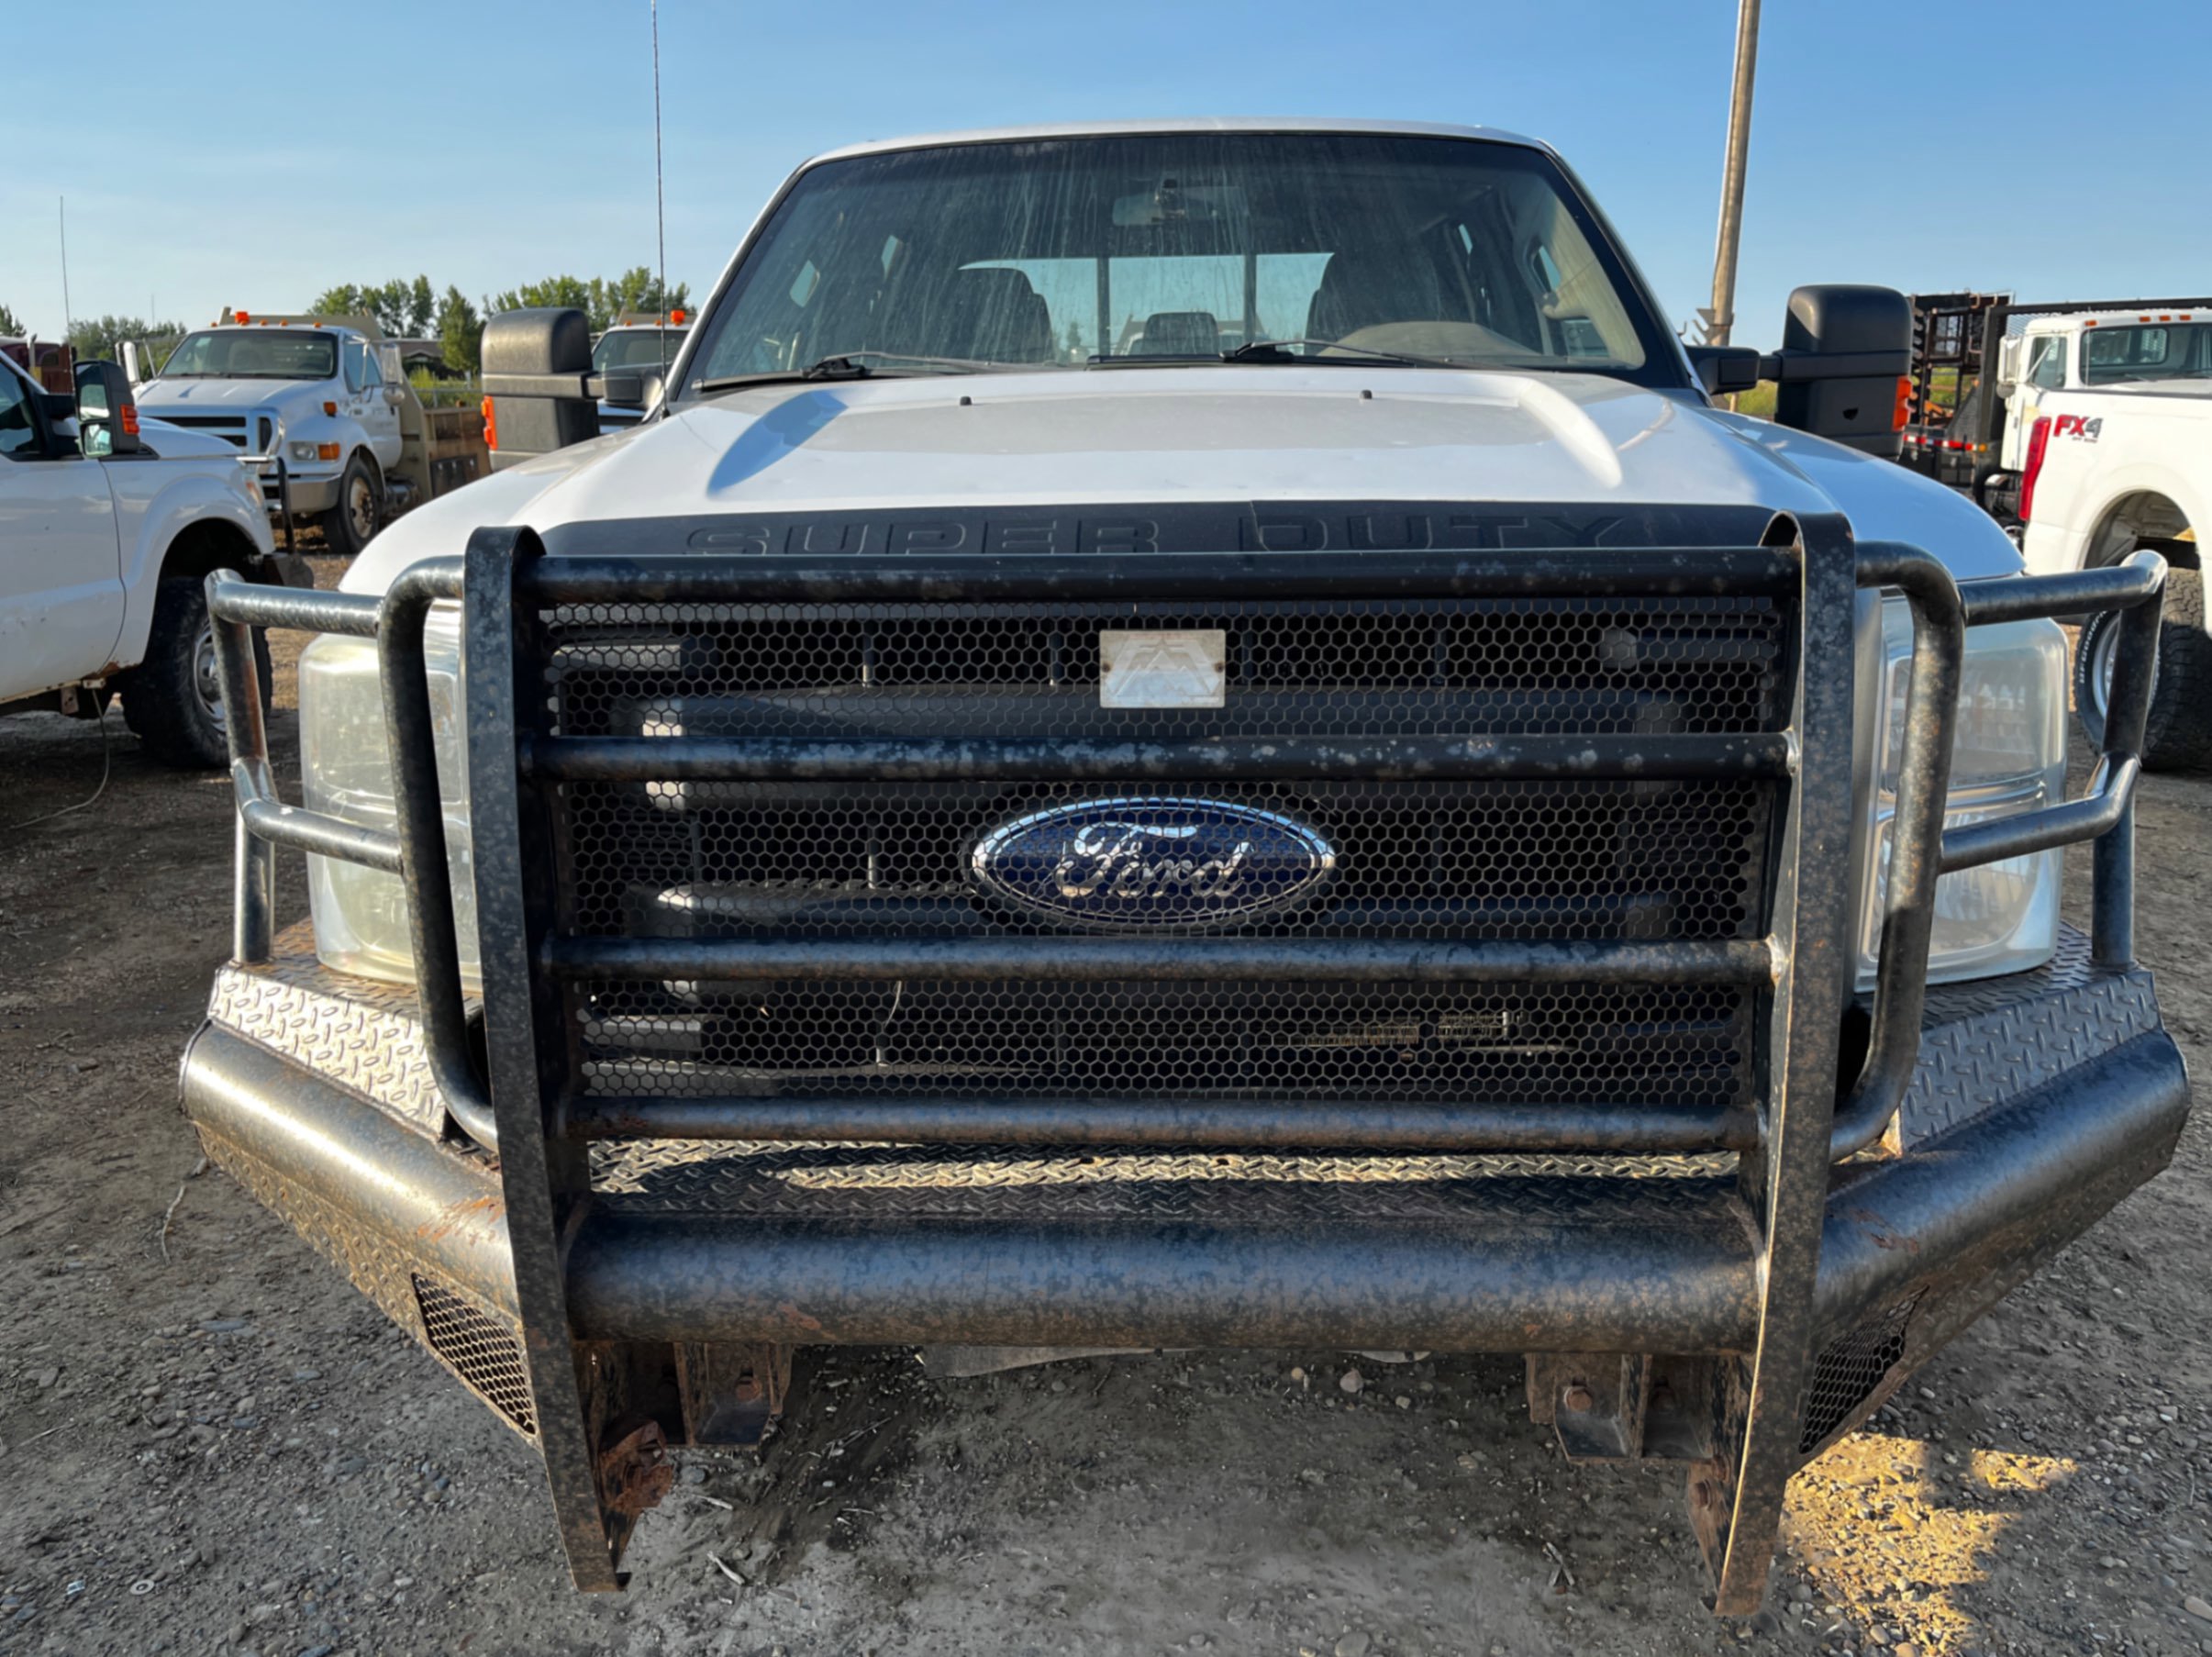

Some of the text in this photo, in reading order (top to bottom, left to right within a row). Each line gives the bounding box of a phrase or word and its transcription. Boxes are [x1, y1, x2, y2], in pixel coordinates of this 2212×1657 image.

[2053, 414, 2104, 439] FX4
[686, 516, 1626, 555] SUPER DUTY
[1036, 822, 1253, 897] Ford
